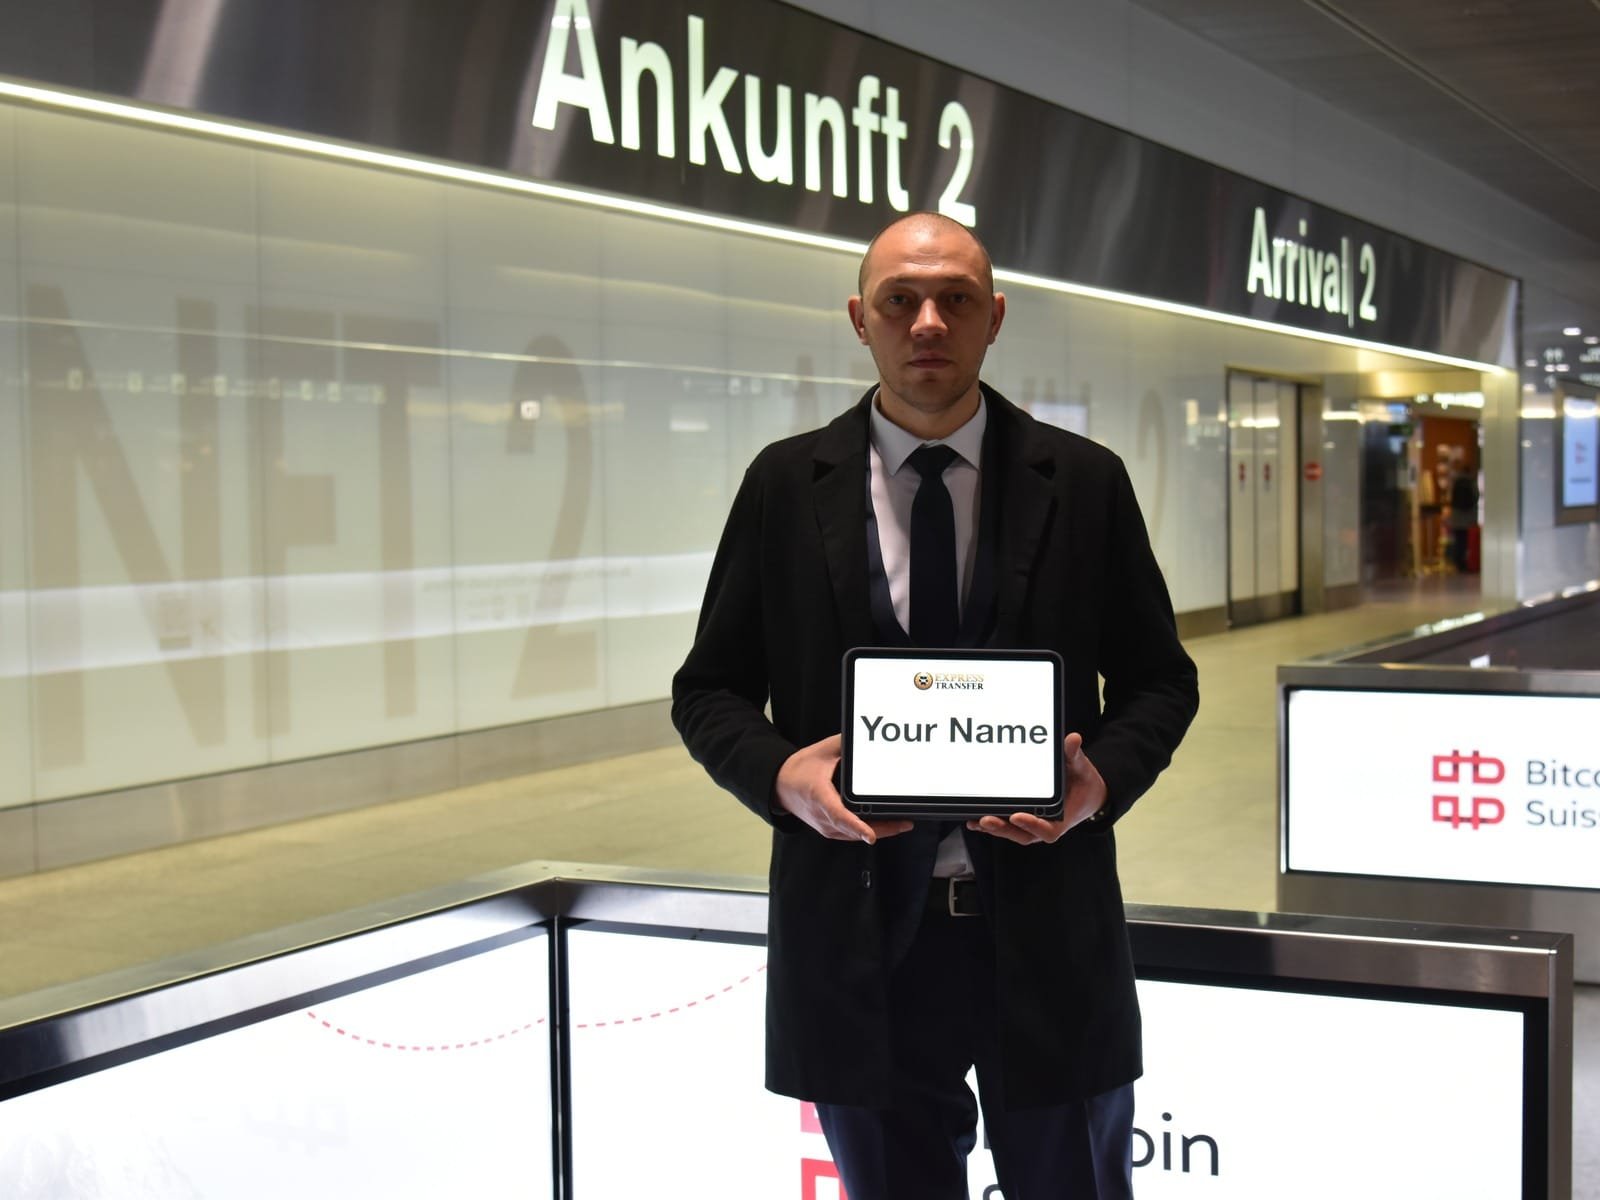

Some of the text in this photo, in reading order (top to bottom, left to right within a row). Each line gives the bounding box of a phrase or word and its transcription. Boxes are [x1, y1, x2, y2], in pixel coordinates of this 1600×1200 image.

[532, 0, 977, 228] Ankunft 2
[1246, 206, 1378, 322] Arrival 2
[935, 672, 985, 682] EXPRESS
[935, 682, 984, 690] TRANSFER
[860, 715, 1048, 744] Your Name
[1527, 800, 1600, 828] Suis
